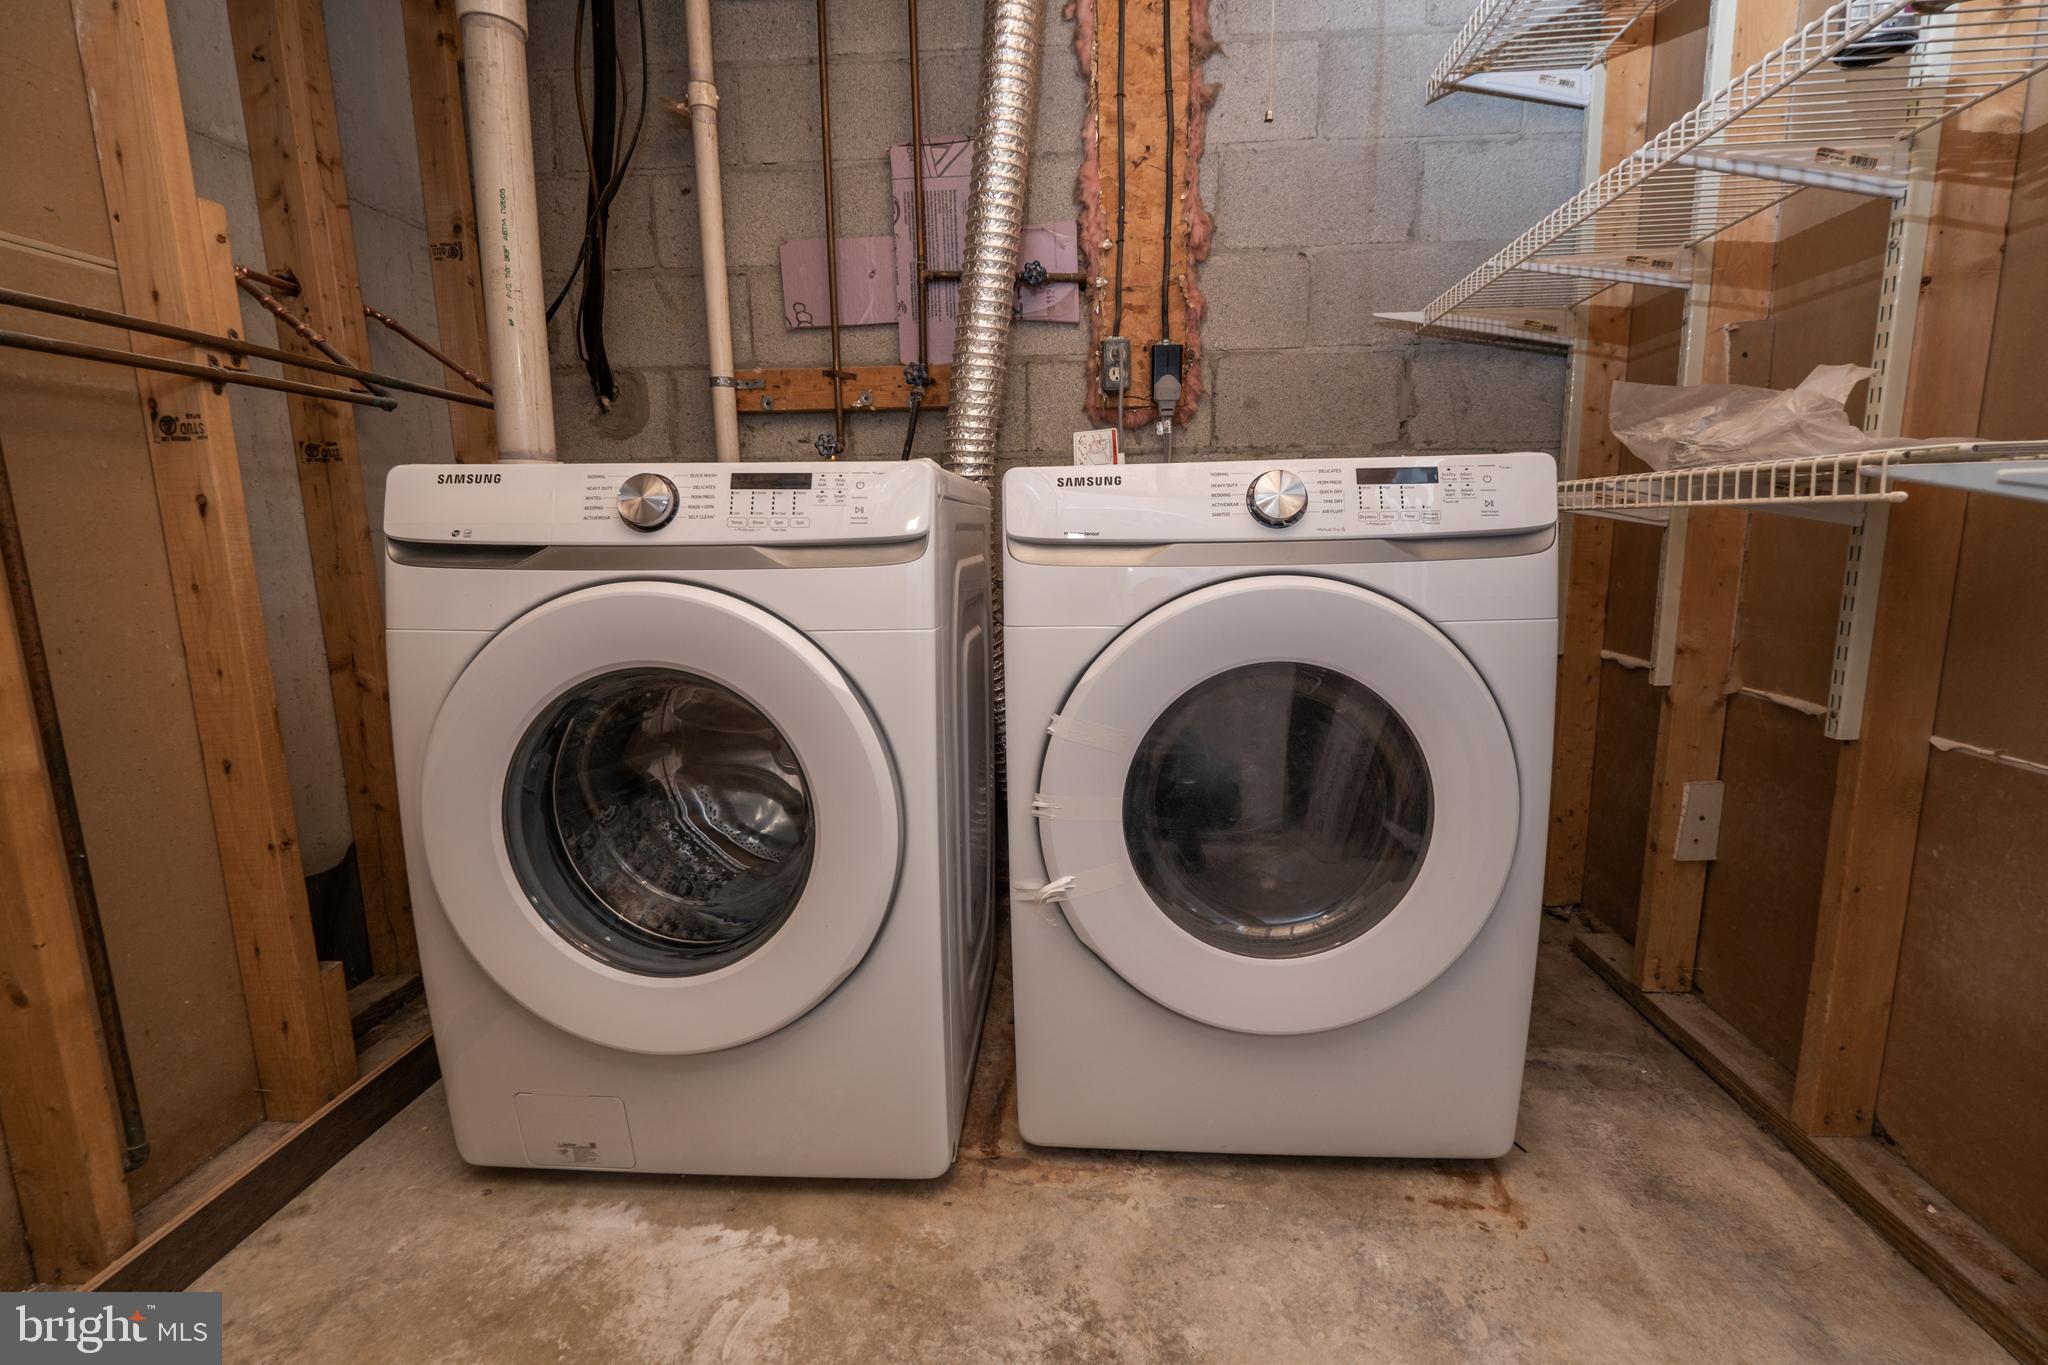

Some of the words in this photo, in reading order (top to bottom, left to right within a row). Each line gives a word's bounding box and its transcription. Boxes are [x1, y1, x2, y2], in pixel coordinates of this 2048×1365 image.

[180, 423, 204, 435] STUD
[437, 474, 501, 484] SAMSUNG
[1057, 476, 1122, 487] SAMSUNG
